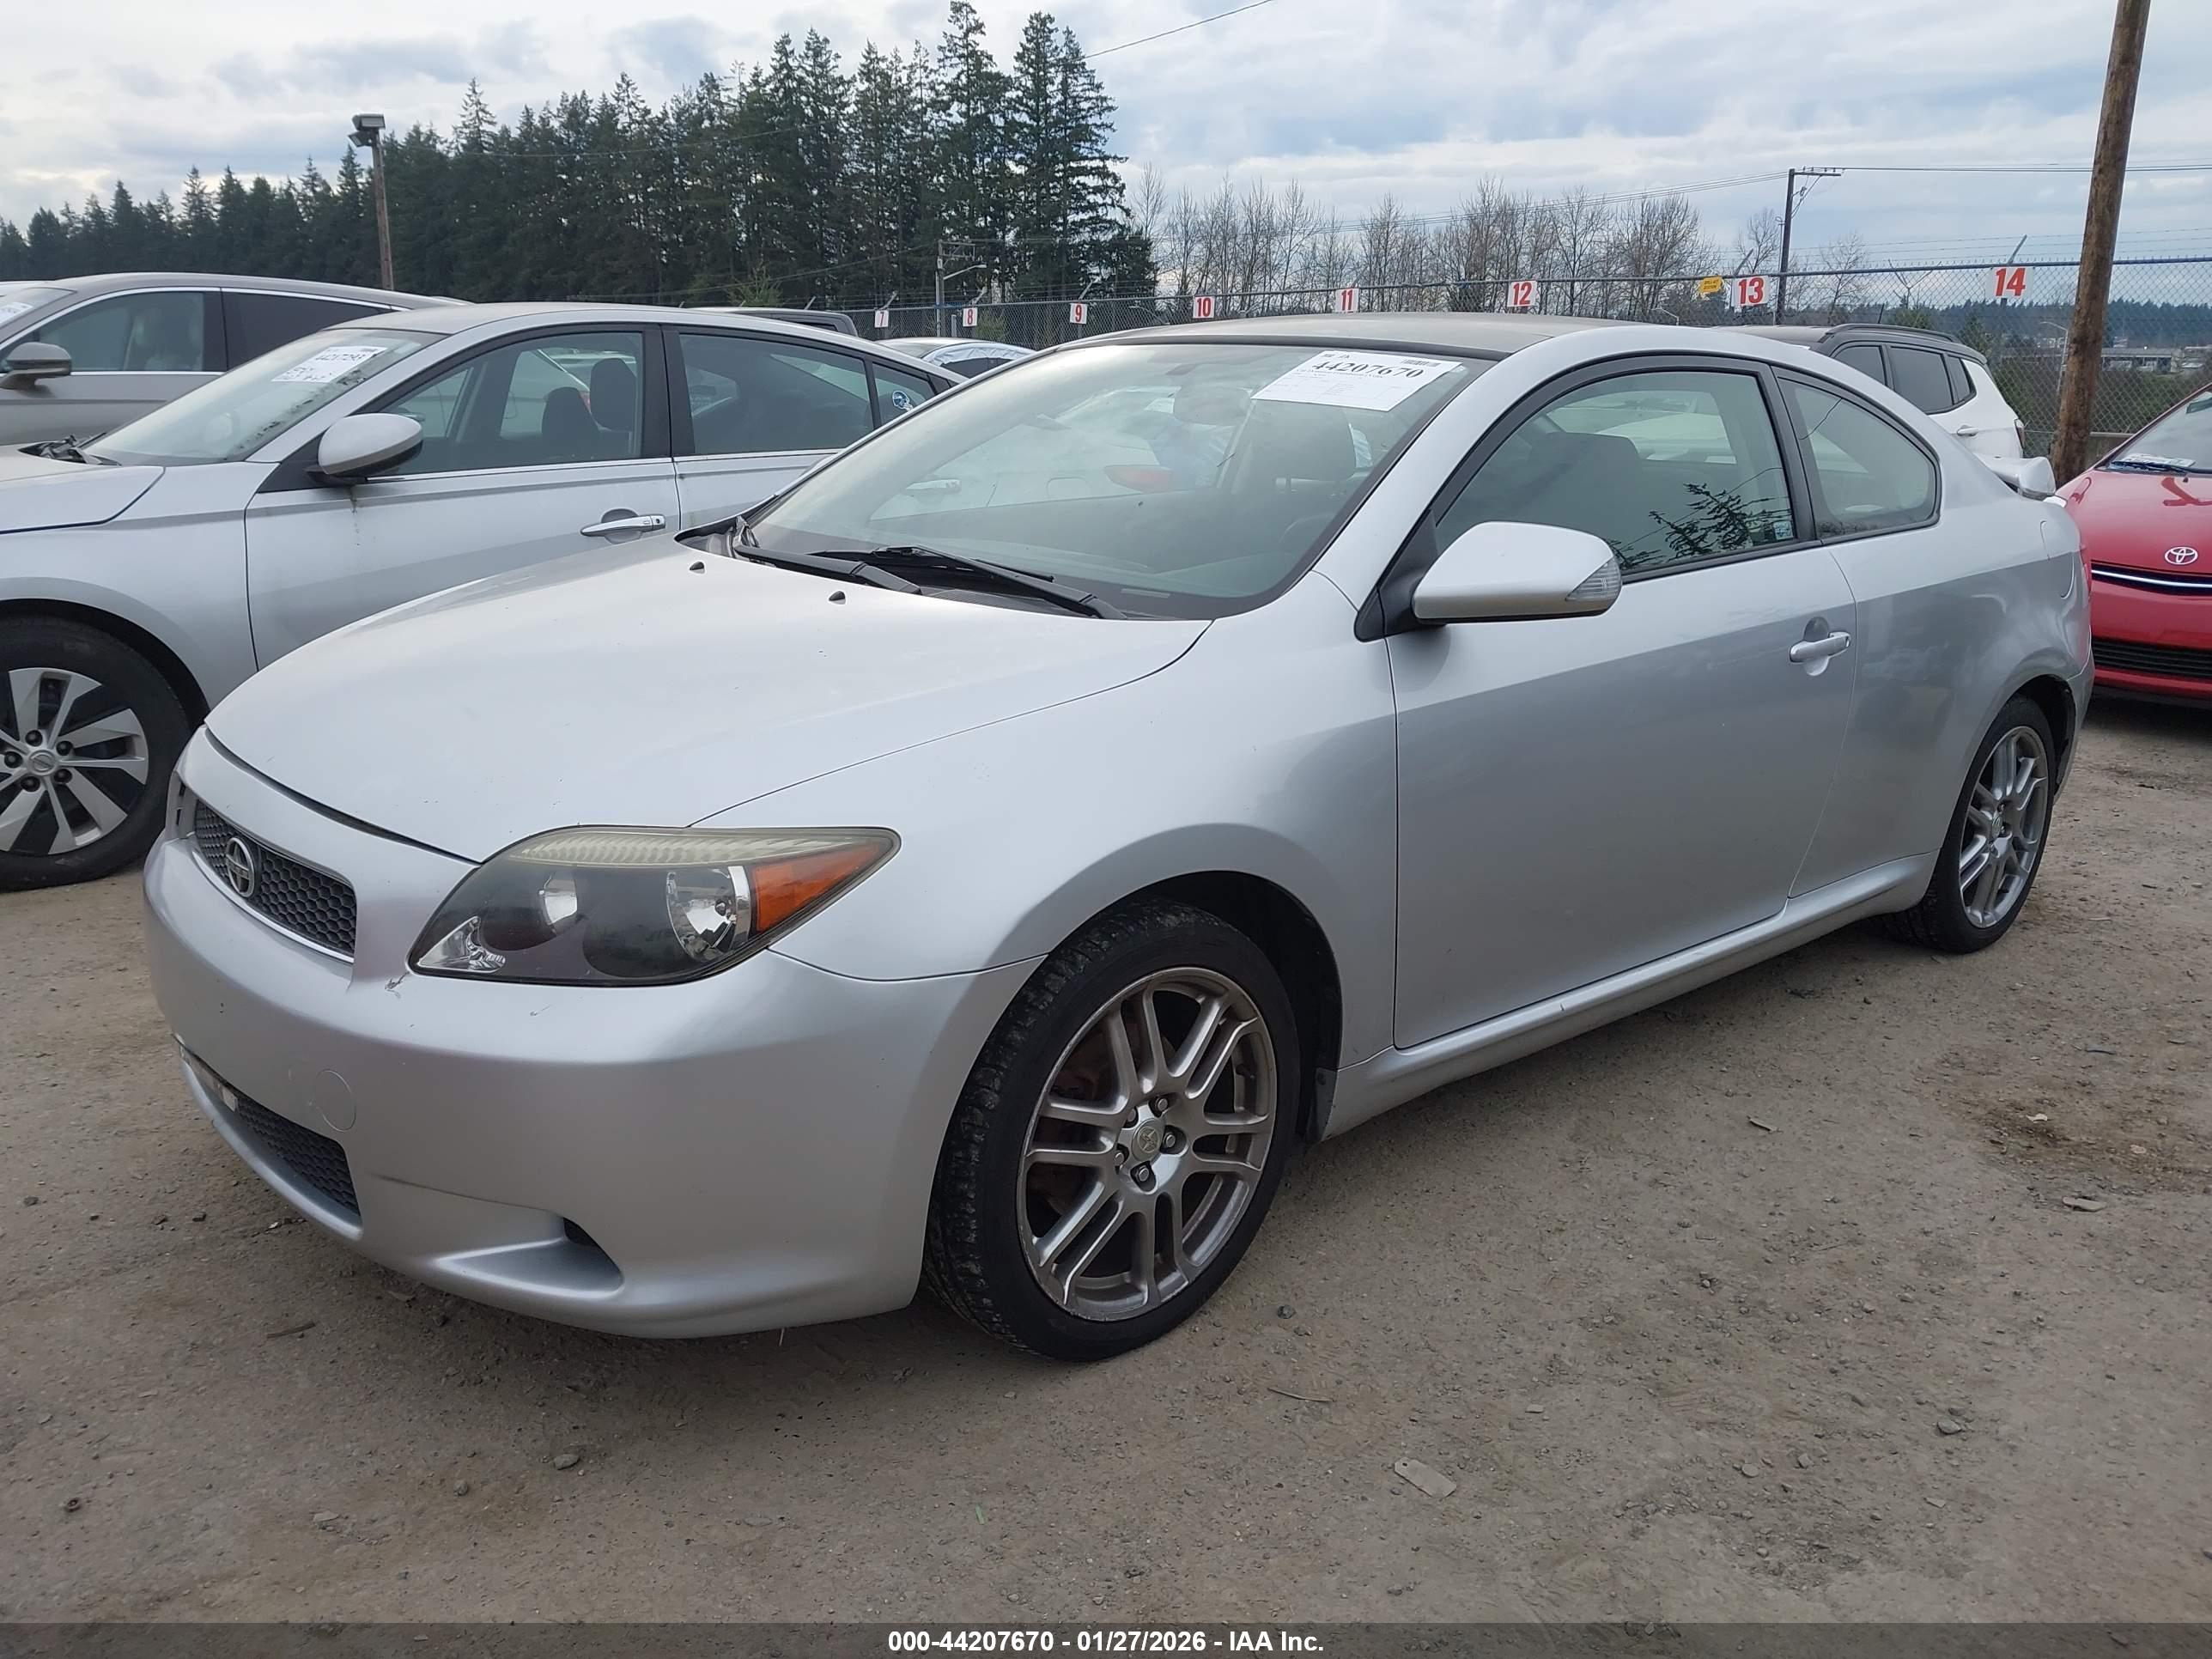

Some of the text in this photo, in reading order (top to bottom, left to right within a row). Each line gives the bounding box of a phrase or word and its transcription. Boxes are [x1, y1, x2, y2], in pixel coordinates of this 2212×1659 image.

[1738, 277, 1765, 304] 13
[1995, 267, 2027, 296] 14
[1341, 289, 1353, 311] 11
[1513, 282, 1532, 306] 12
[967, 308, 974, 325] 8
[1075, 304, 1082, 323] 9
[1196, 297, 1212, 317] 10
[879, 311, 885, 327] 7
[1311, 361, 1424, 378] 44207670
